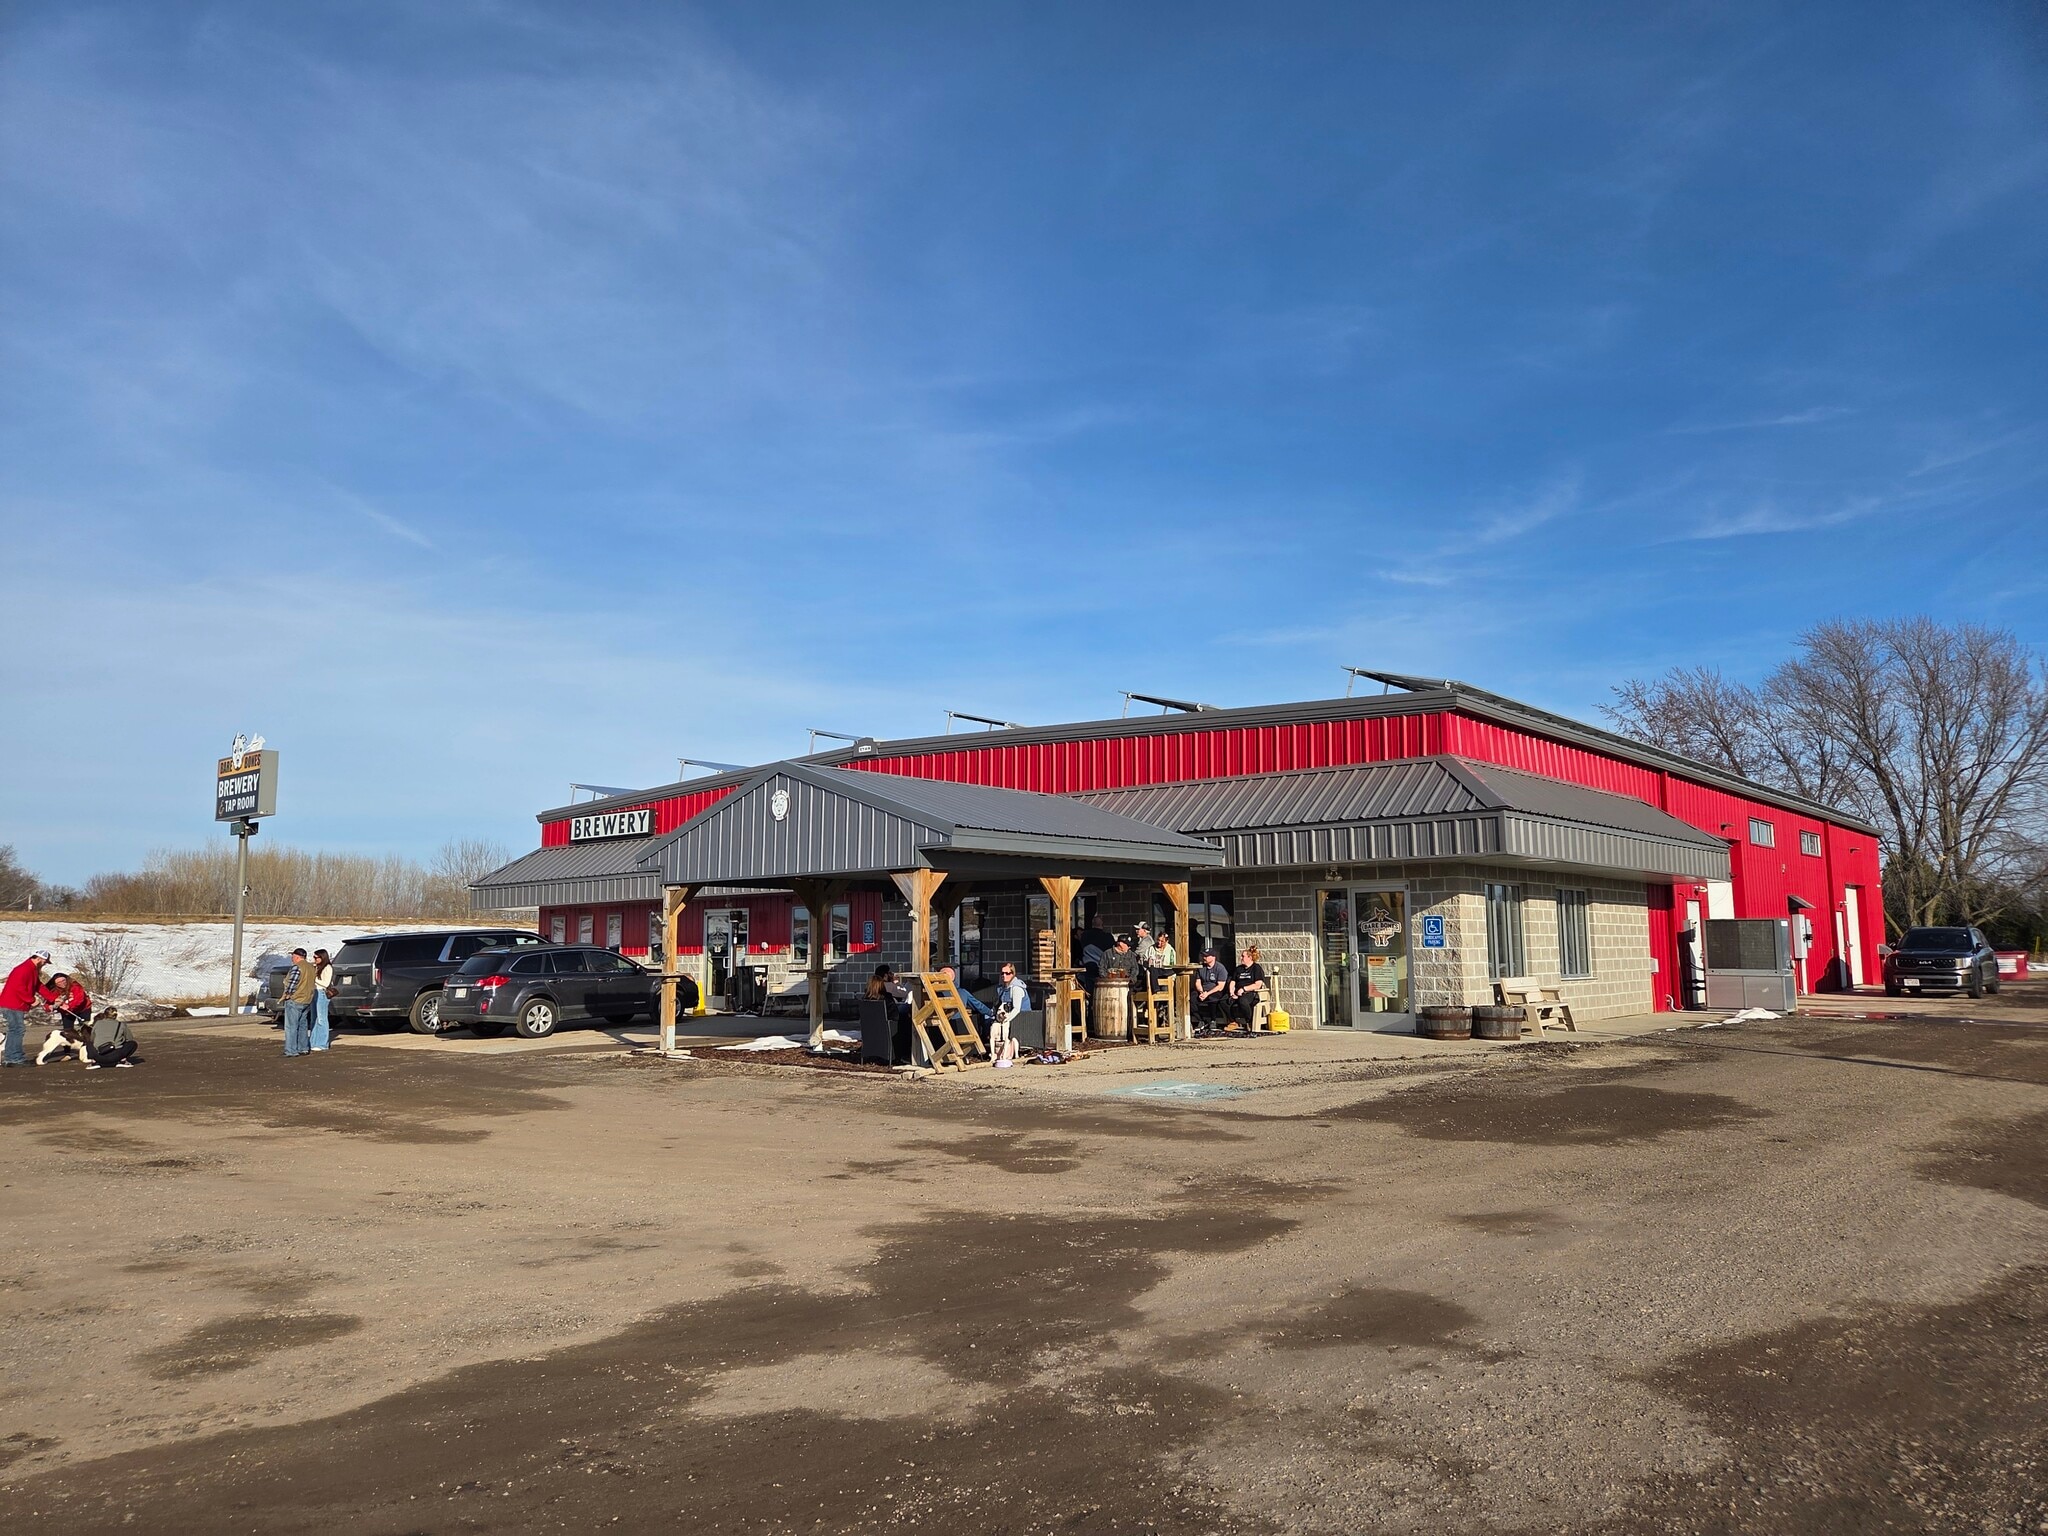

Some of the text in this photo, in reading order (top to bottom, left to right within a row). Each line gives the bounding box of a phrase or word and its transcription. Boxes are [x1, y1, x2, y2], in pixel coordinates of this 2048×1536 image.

[244, 754, 261, 768] BONES
[218, 773, 260, 798] BREWERY
[225, 799, 236, 812] TAP
[237, 795, 255, 810] ROOM
[574, 811, 647, 838] BREWERY
